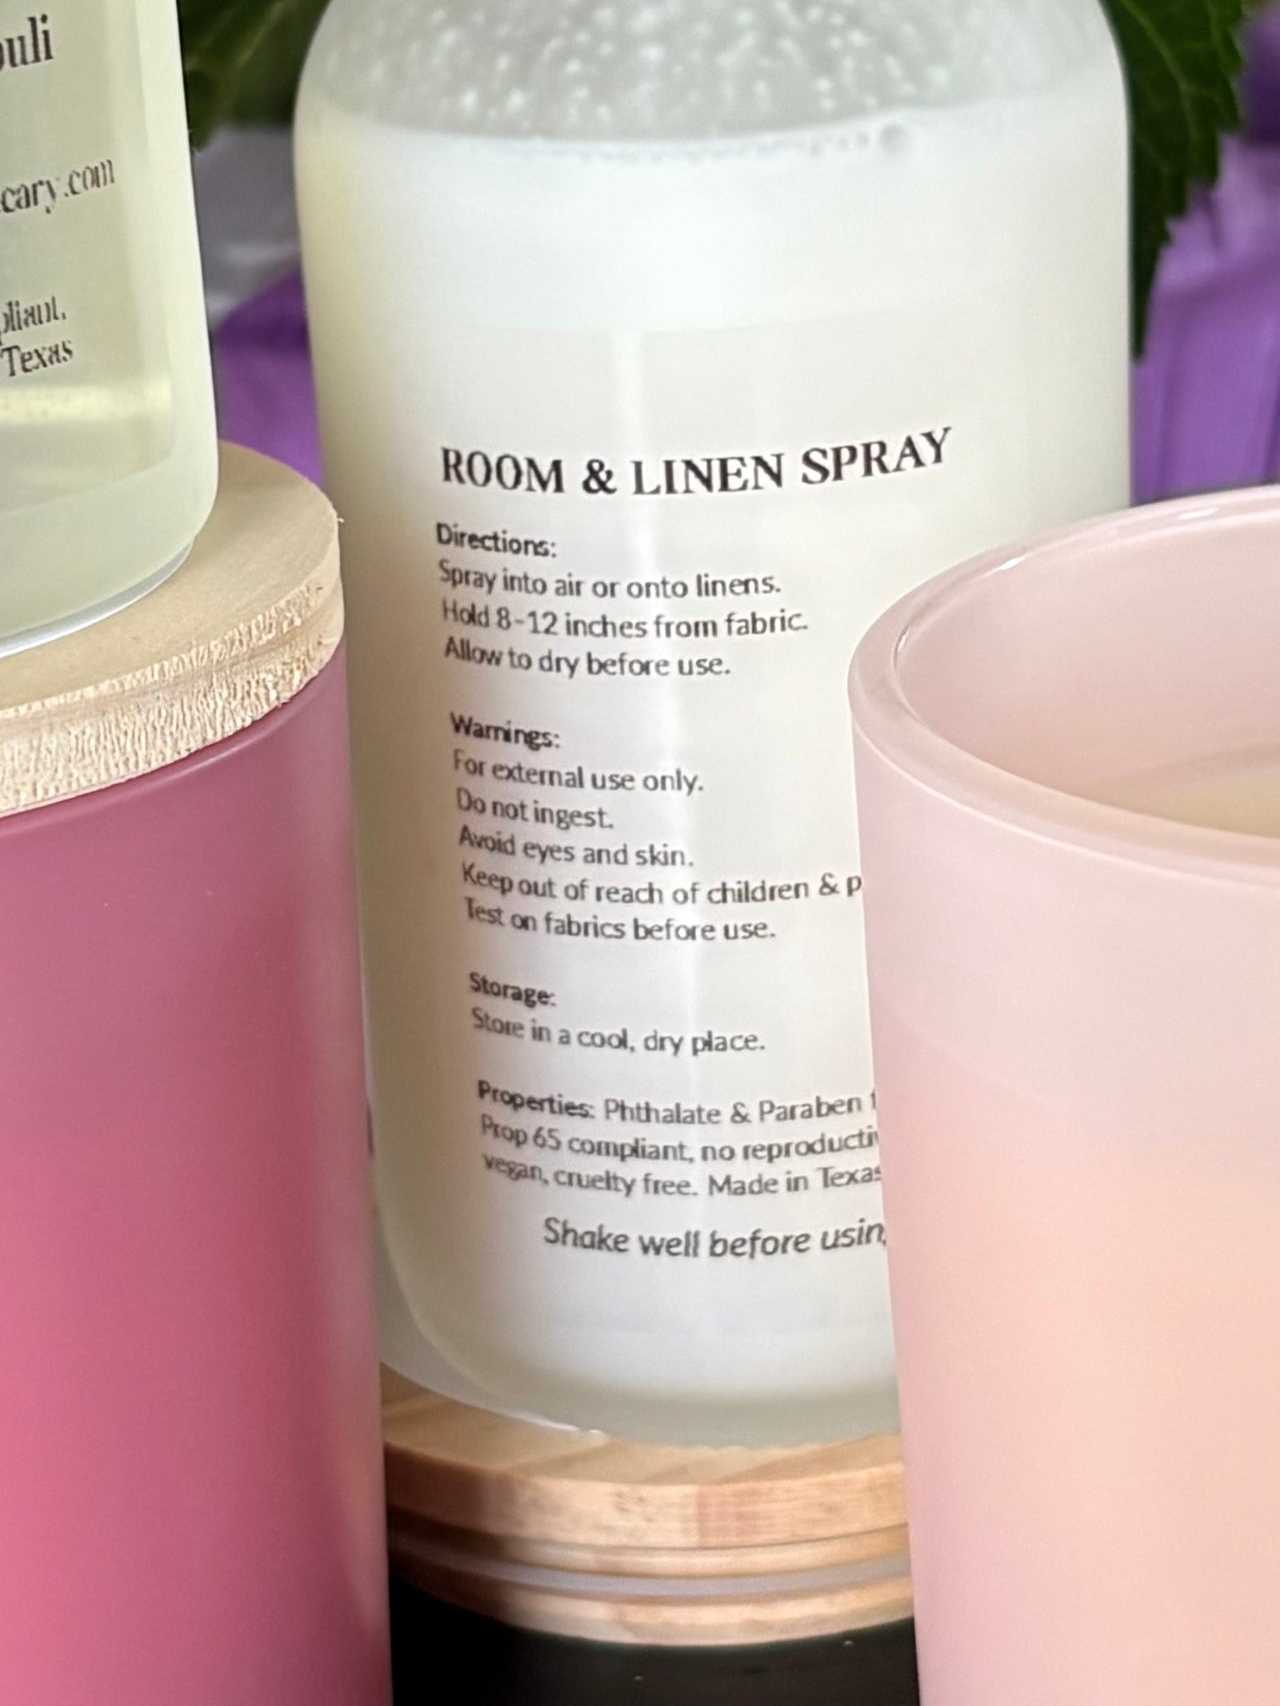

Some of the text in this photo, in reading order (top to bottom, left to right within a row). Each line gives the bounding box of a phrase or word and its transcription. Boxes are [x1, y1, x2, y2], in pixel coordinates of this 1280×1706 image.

[0, 339, 75, 378] Texas
[440, 426, 952, 496] ROOM & LINEN SPRAY
[435, 521, 557, 559] Directions:
[438, 558, 781, 599] Spray into air or onto linens.
[441, 597, 809, 640] Hold 8-12 inches from fabric.
[443, 635, 732, 681] Allow to dry before use.
[449, 710, 561, 752] Warnings:
[452, 748, 705, 797] For external use only.
[455, 786, 615, 831] Do not ingest.
[457, 823, 695, 867] Avoid eyes and skin.
[461, 860, 514, 897] Keep
[518, 876, 558, 899] out
[563, 878, 590, 902] of
[594, 880, 665, 905] reach
[671, 880, 701, 905] of
[706, 879, 810, 905] children
[817, 871, 841, 897] &
[463, 895, 777, 942] Test on fabrics before use.
[468, 971, 557, 1009] Storage:
[470, 1006, 767, 1057] Store in a cool, dry place.
[476, 1079, 596, 1120] Properties:
[603, 1097, 722, 1127] Phthalate
[729, 1101, 752, 1125] &
[758, 1094, 863, 1123] Paraben
[480, 1112, 528, 1149] Prop
[531, 1125, 562, 1151] 65
[700, 1143, 736, 1163] no
[482, 1152, 550, 1186] vegan,
[552, 1169, 637, 1198] cruelty
[643, 1172, 699, 1198] free.
[707, 1172, 780, 1198] Made
[785, 1170, 810, 1194] in
[543, 1215, 888, 1261] Shake well before usin
